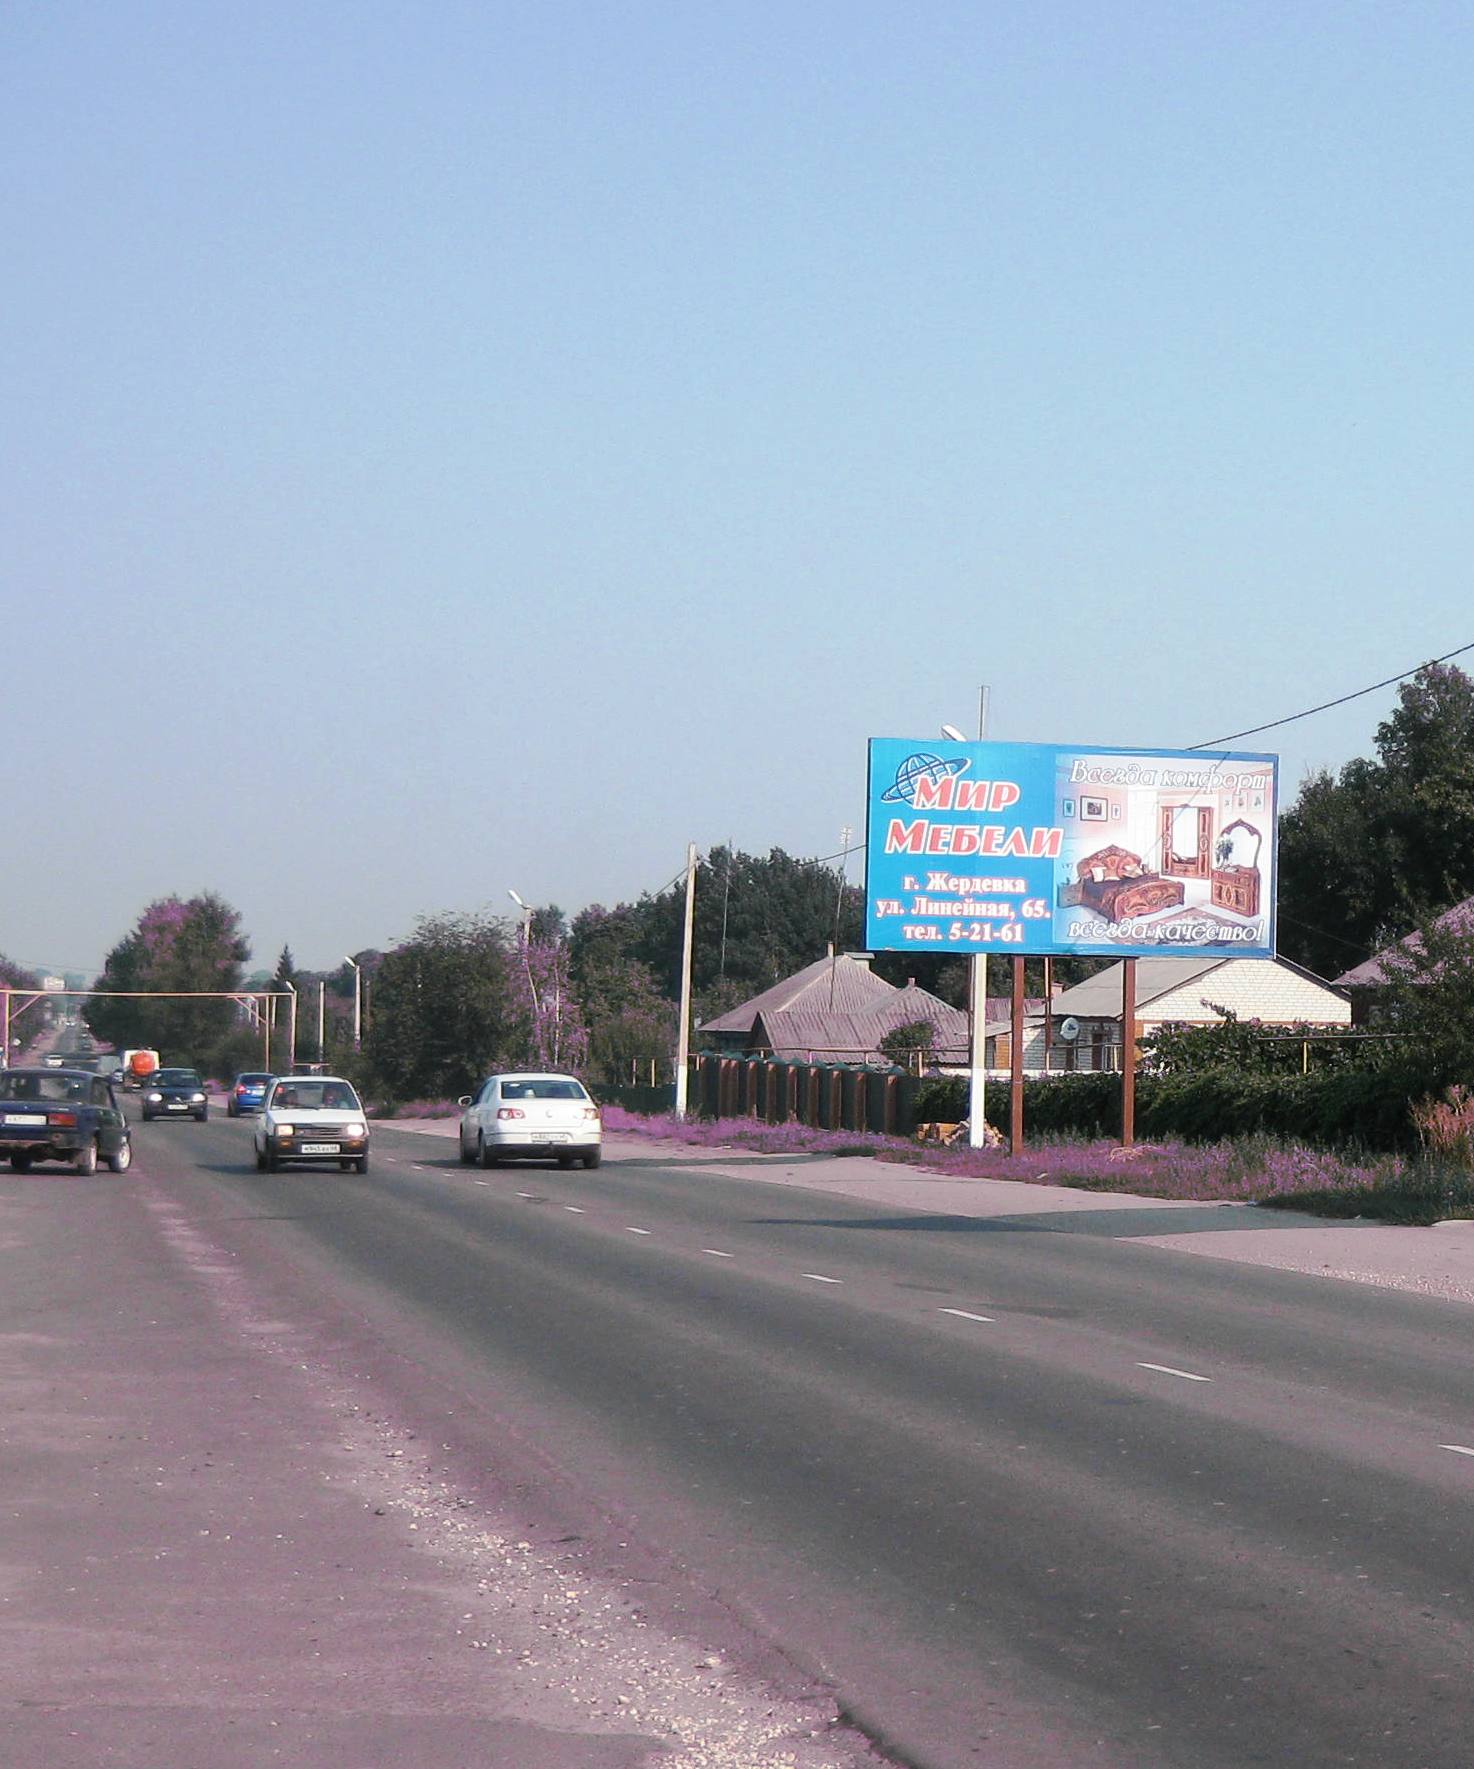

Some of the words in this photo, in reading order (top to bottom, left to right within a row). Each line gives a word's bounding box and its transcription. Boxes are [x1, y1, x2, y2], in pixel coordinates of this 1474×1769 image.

[1069, 759, 1156, 788] Всегда
[1159, 764, 1266, 794] комфорт
[903, 876, 919, 890] г.
[926, 872, 1026, 895] Жердевка
[876, 900, 905, 918] ул.
[911, 896, 1016, 921] Линейная,
[1021, 900, 1051, 919] 65.
[902, 925, 944, 941] тел.
[948, 922, 1025, 943] 5-21-61
[1068, 917, 1148, 940] всегда
[1153, 921, 1264, 942] качество!
